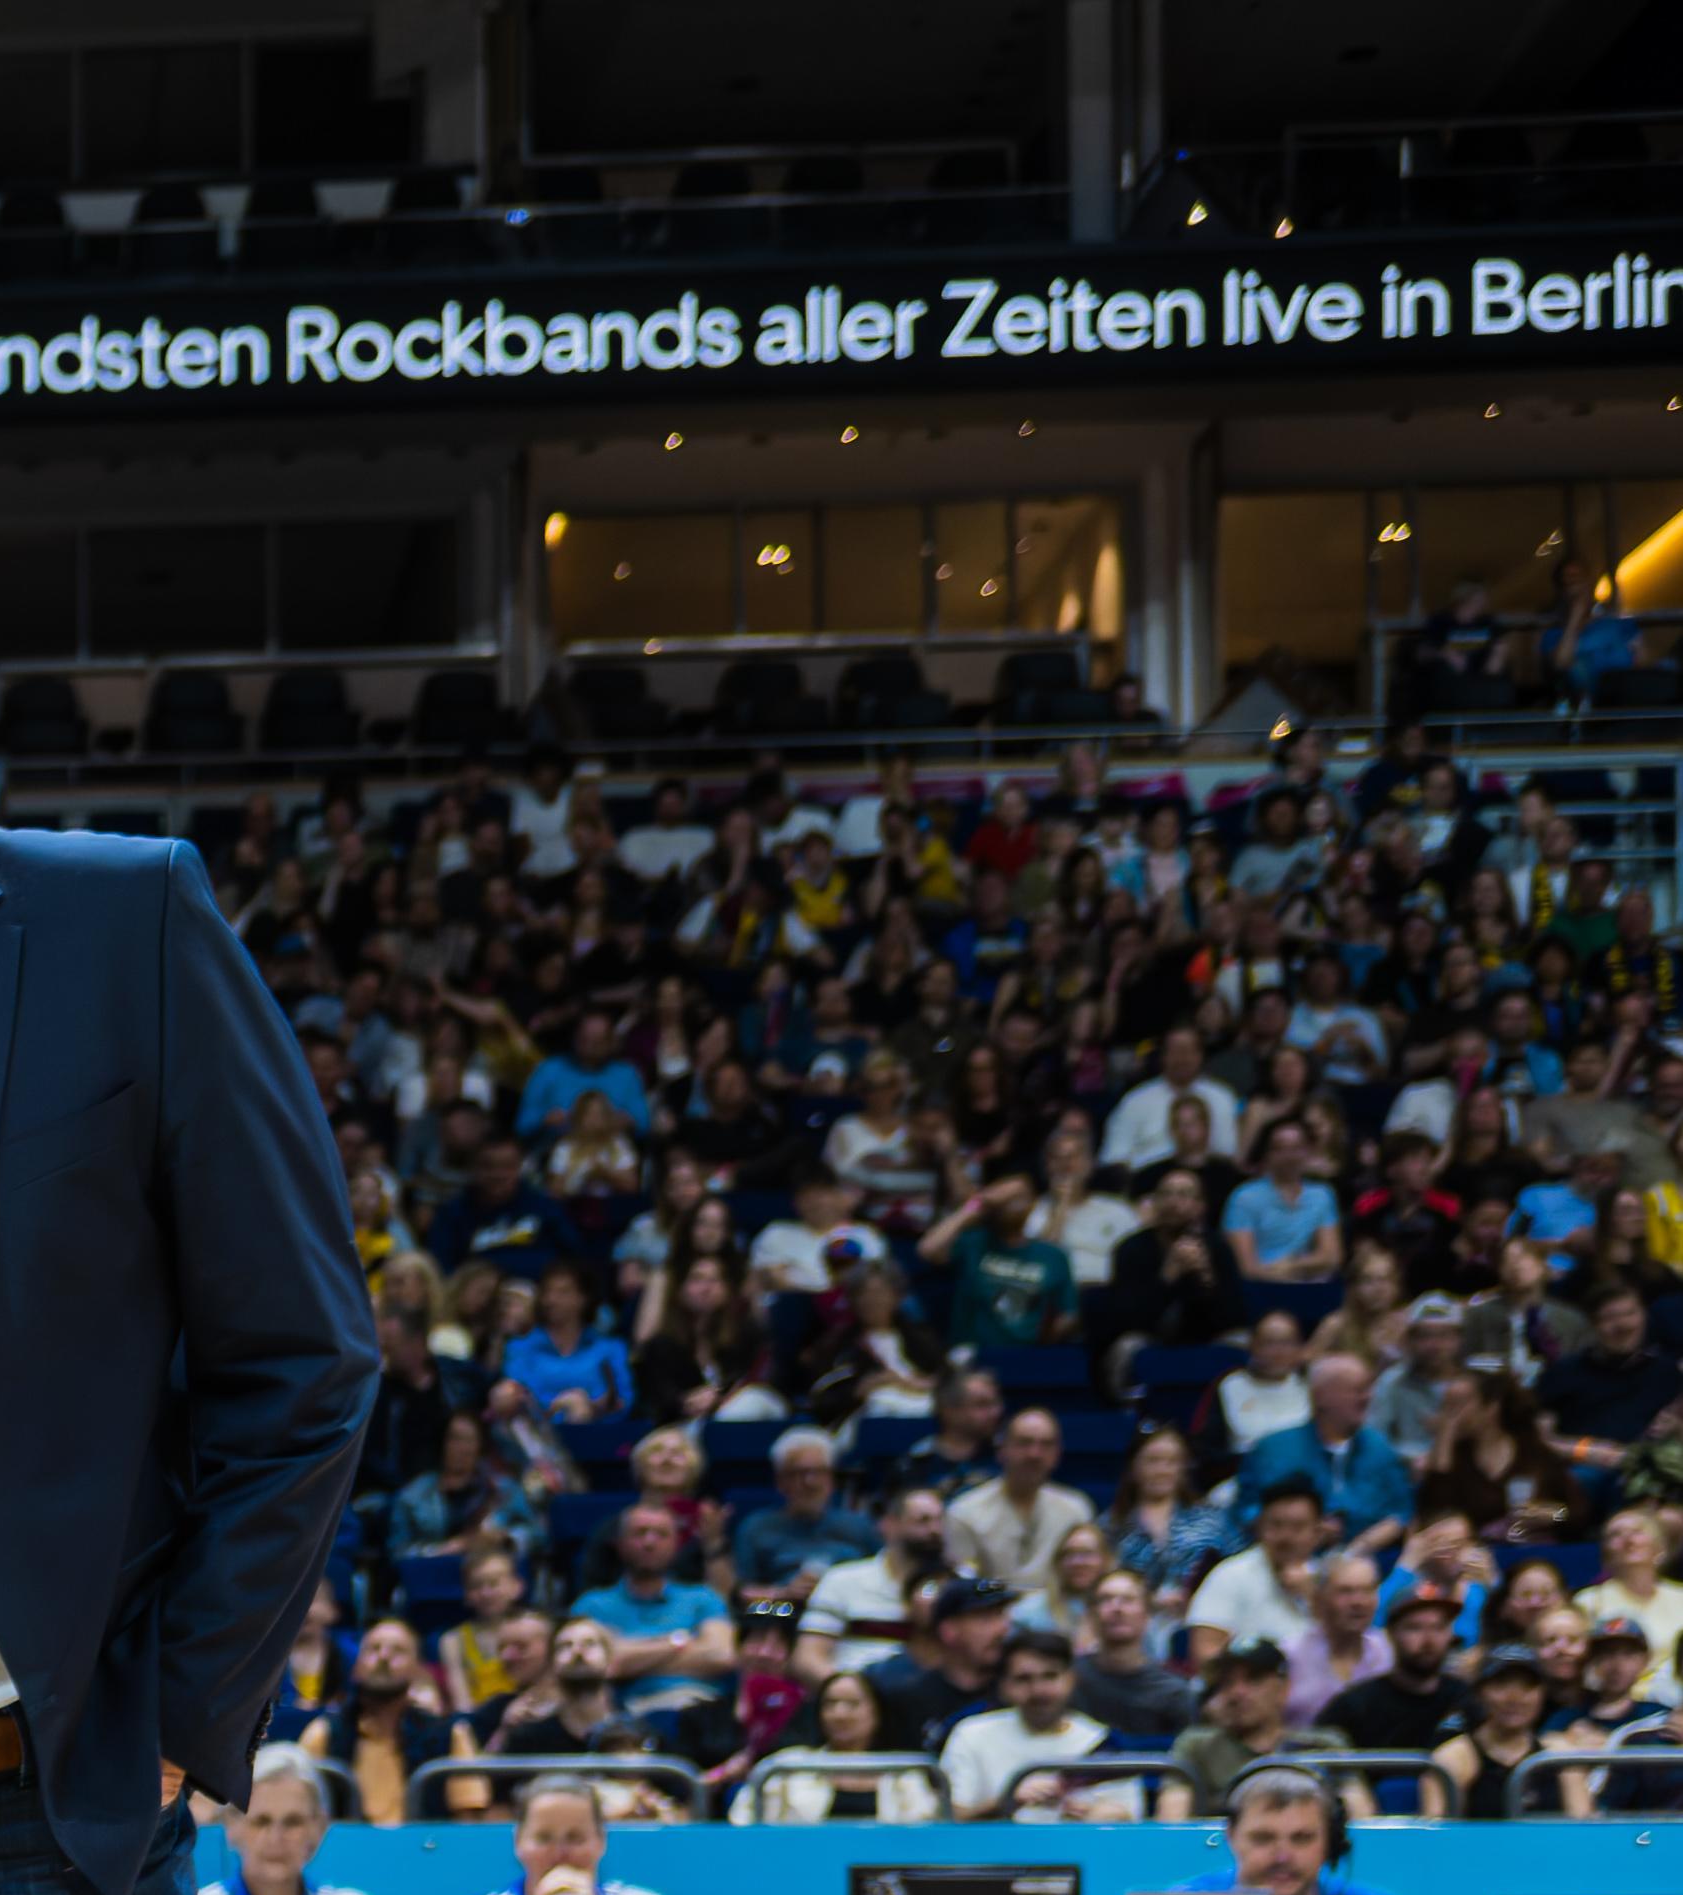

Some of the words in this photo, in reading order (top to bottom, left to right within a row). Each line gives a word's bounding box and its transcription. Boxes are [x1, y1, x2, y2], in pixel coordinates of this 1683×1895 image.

[287, 291, 741, 384] Rockbands
[754, 287, 927, 366] aller
[941, 278, 1205, 359] Zeiten
[1223, 268, 1362, 346] live
[1382, 264, 1449, 340] in
